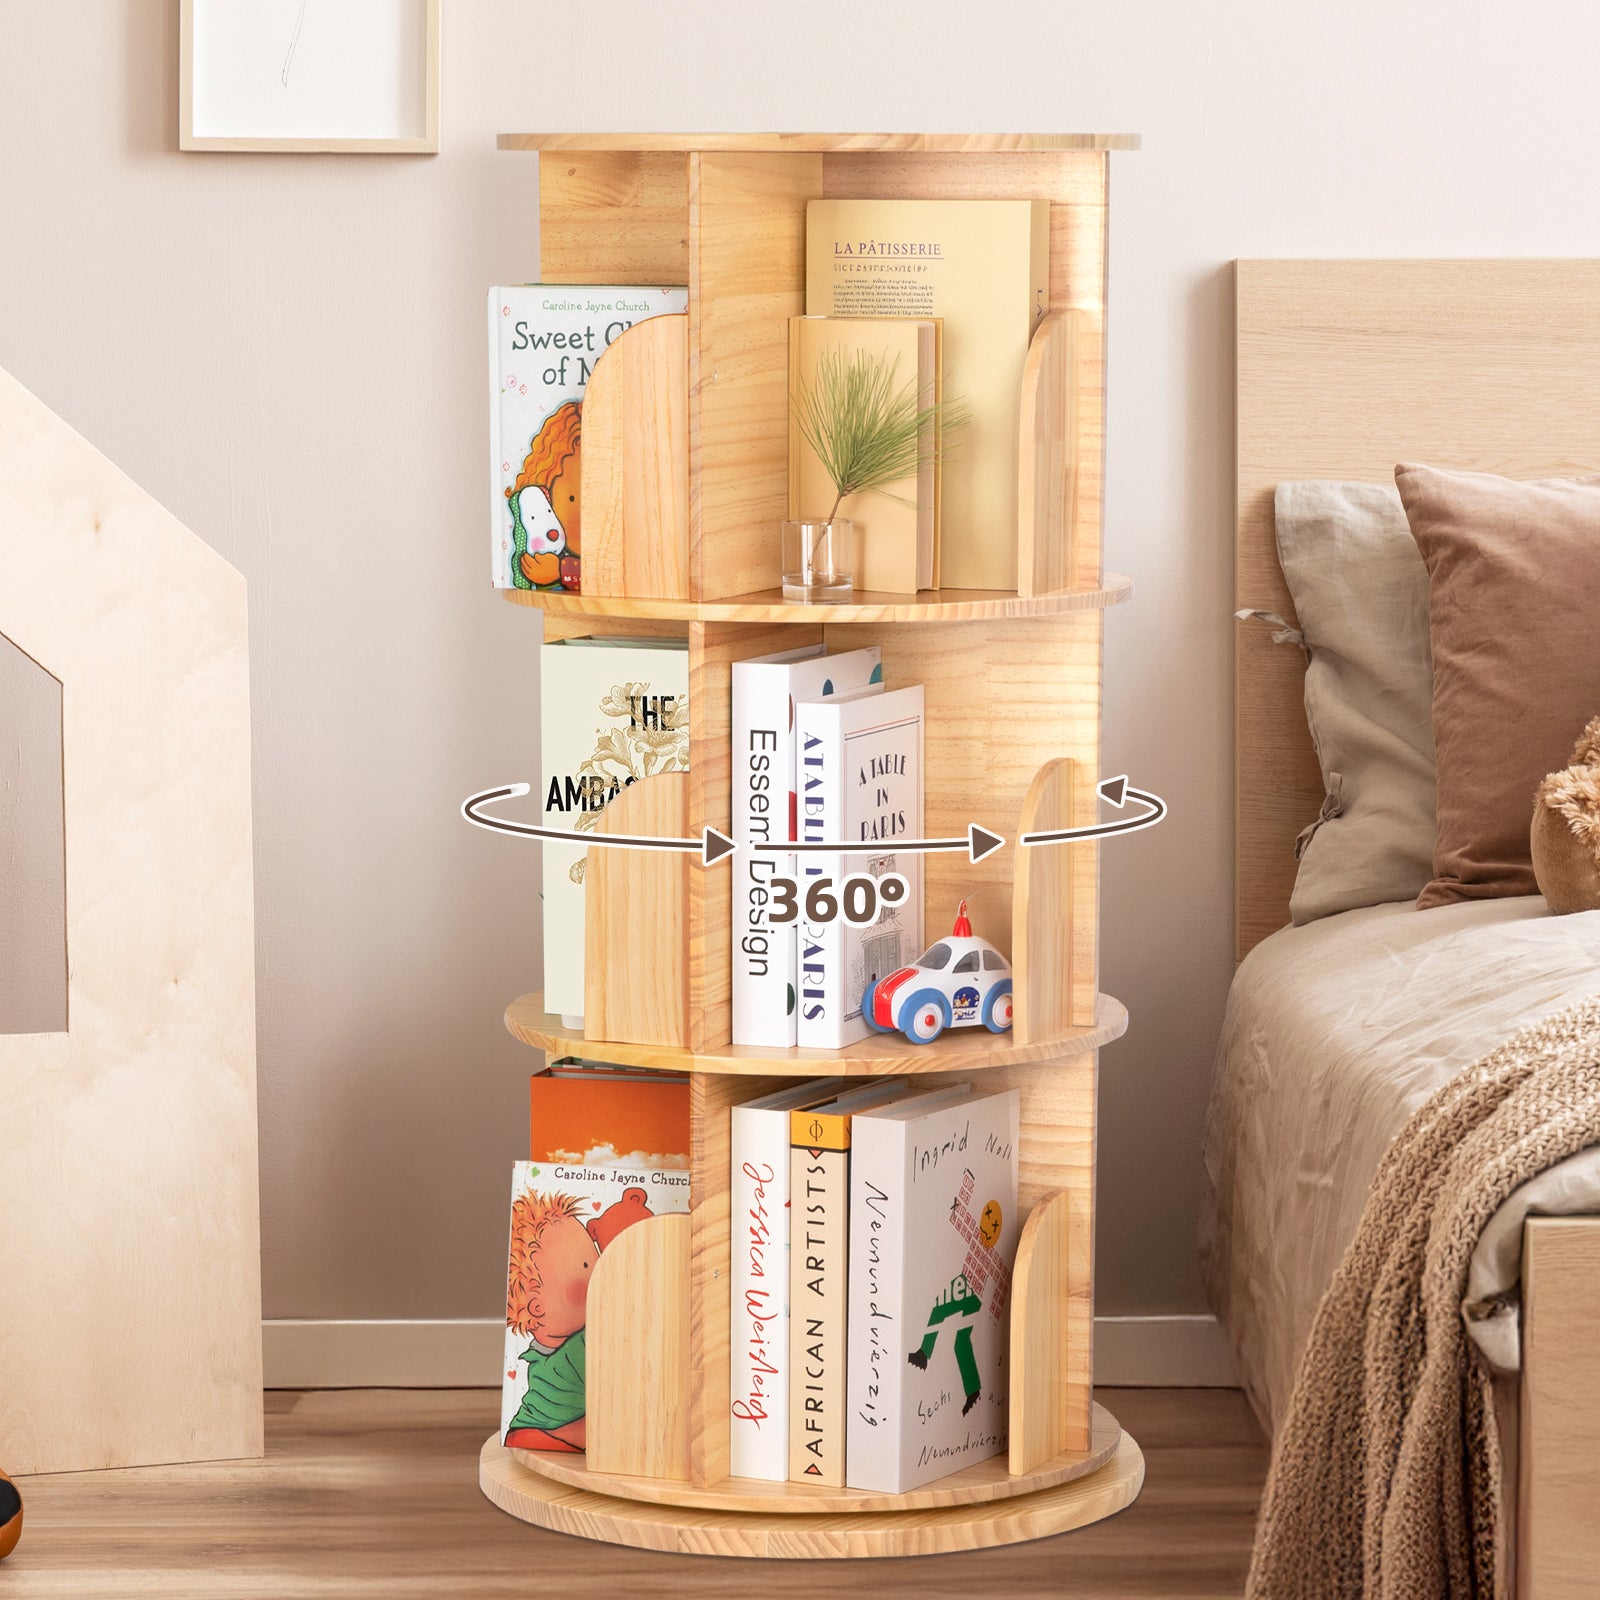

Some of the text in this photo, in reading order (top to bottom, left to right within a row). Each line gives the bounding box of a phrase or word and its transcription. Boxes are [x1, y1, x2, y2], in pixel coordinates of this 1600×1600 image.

[834, 240, 941, 255] LA PÂTISSERIE
[542, 300, 650, 313] Caroline Jayne Church
[512, 321, 633, 351] Sweet C
[542, 356, 570, 386] of
[629, 696, 675, 731] THE
[870, 753, 907, 779] TABLE
[876, 787, 889, 807] IN
[860, 810, 906, 841] PARIS
[741, 860, 776, 977] Design
[913, 1120, 1013, 1183] Ingrid Noll
[554, 1167, 606, 1181] Caroline
[610, 1170, 646, 1186] Jayne
[742, 1161, 775, 1277] Jessica
[804, 1165, 826, 1458] AFRICAN ARTISTS
